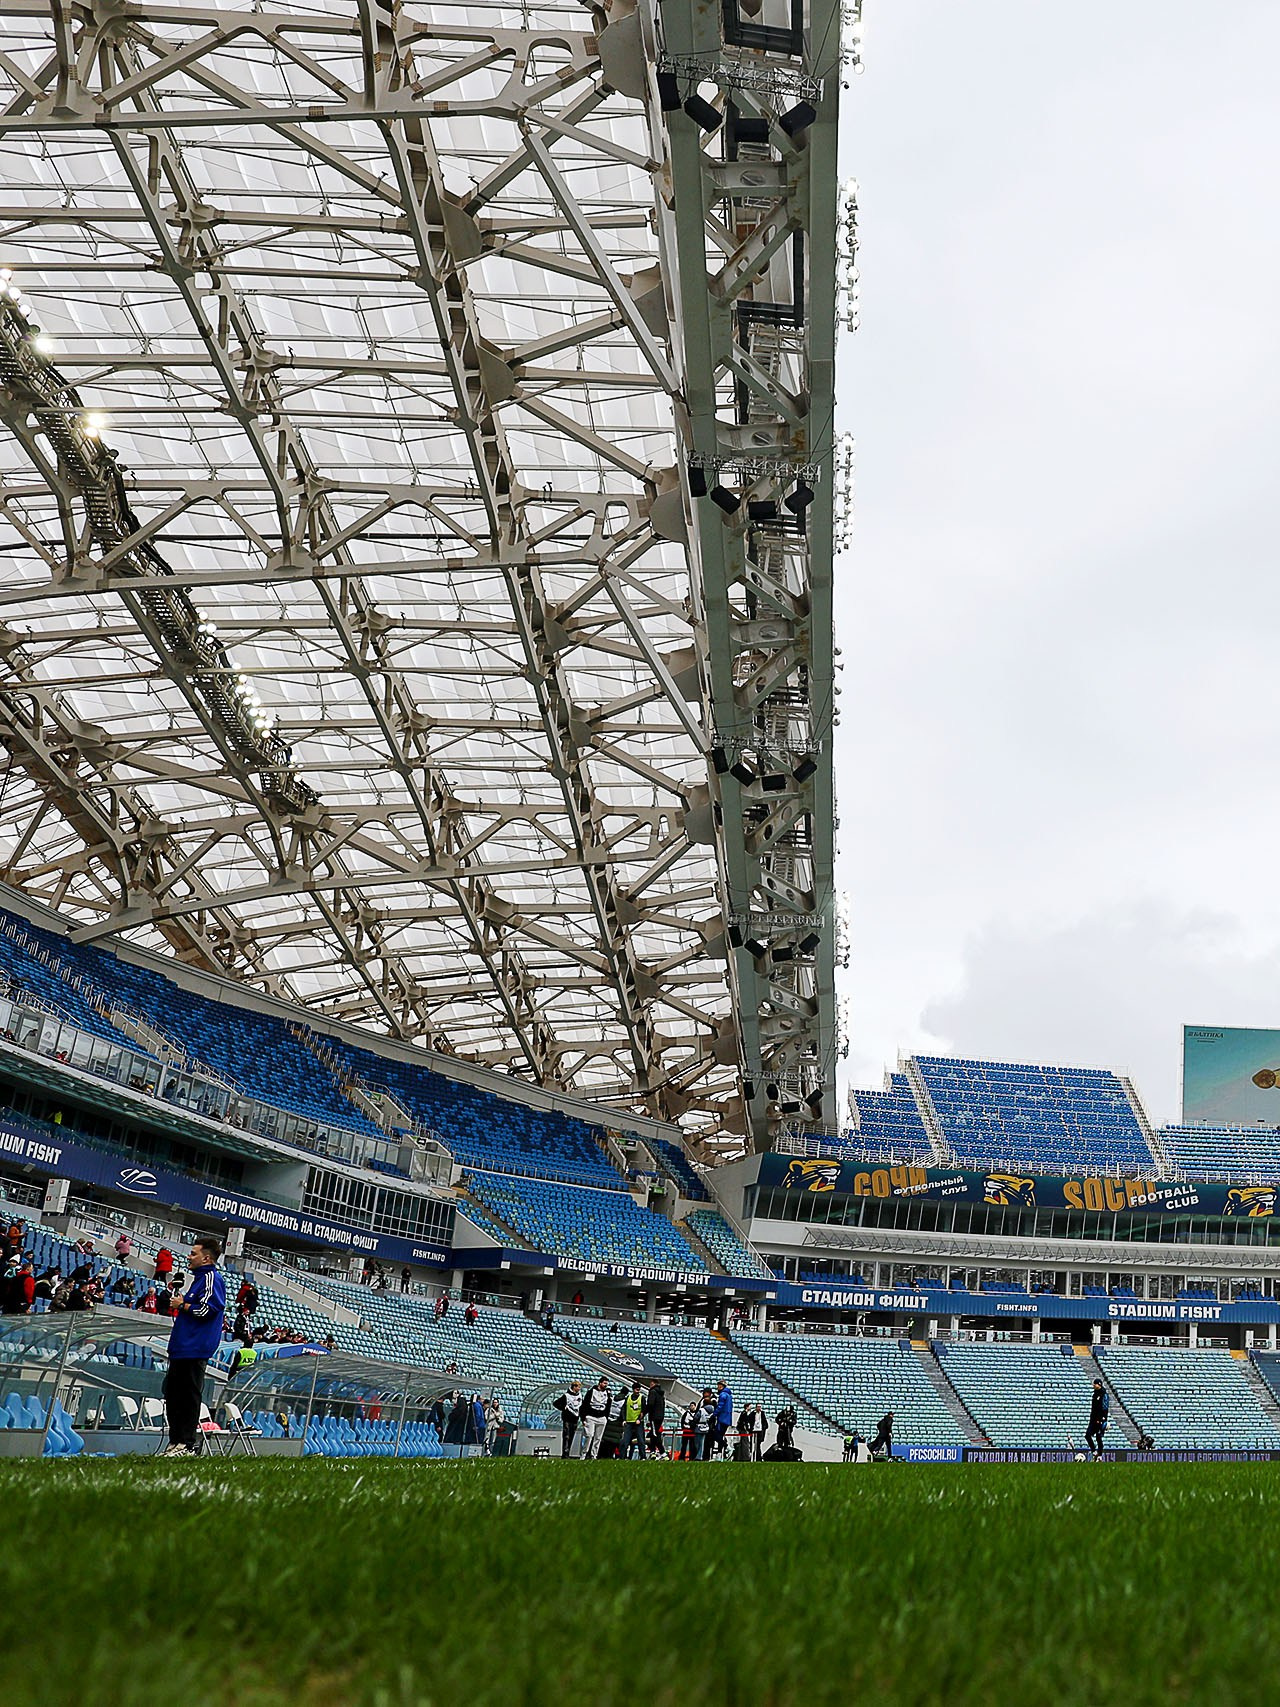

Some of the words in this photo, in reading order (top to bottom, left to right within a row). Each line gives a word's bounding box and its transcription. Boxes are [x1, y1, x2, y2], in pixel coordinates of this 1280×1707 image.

[25, 1141, 62, 1165] FISHT
[854, 1165, 928, 1198] СОЧИ
[893, 1175, 964, 1195] ФУТБОЛЬНЫЙ
[942, 1185, 968, 1196] КЛУБ
[1063, 1177, 1158, 1212] SOCHI
[1130, 1184, 1197, 1206] FOOTBALL
[1165, 1195, 1200, 1210] CLUB
[204, 1193, 238, 1215] ДОБРО
[238, 1203, 299, 1232] ПОЖАЛОВАТЬ
[300, 1221, 313, 1235] НА
[314, 1225, 351, 1245] СТАДИОН
[352, 1234, 379, 1251] ФИШТ
[412, 1248, 446, 1263] FISHT.INFO
[557, 1256, 608, 1275] WELCOME
[610, 1264, 625, 1276] TO
[627, 1267, 676, 1282] STADIUM
[677, 1273, 711, 1286] FISHT
[802, 1289, 875, 1307] СТАДИОН
[879, 1294, 929, 1309] ФИШТ
[996, 1303, 1038, 1312] FISHT.INFO
[1108, 1303, 1176, 1318] STADIUM
[1180, 1306, 1222, 1319] FISHT
[909, 1449, 957, 1461] PFCSOCHI.RU
[1007, 1452, 1019, 1462] НА
[1020, 1452, 1039, 1462] НАШ
